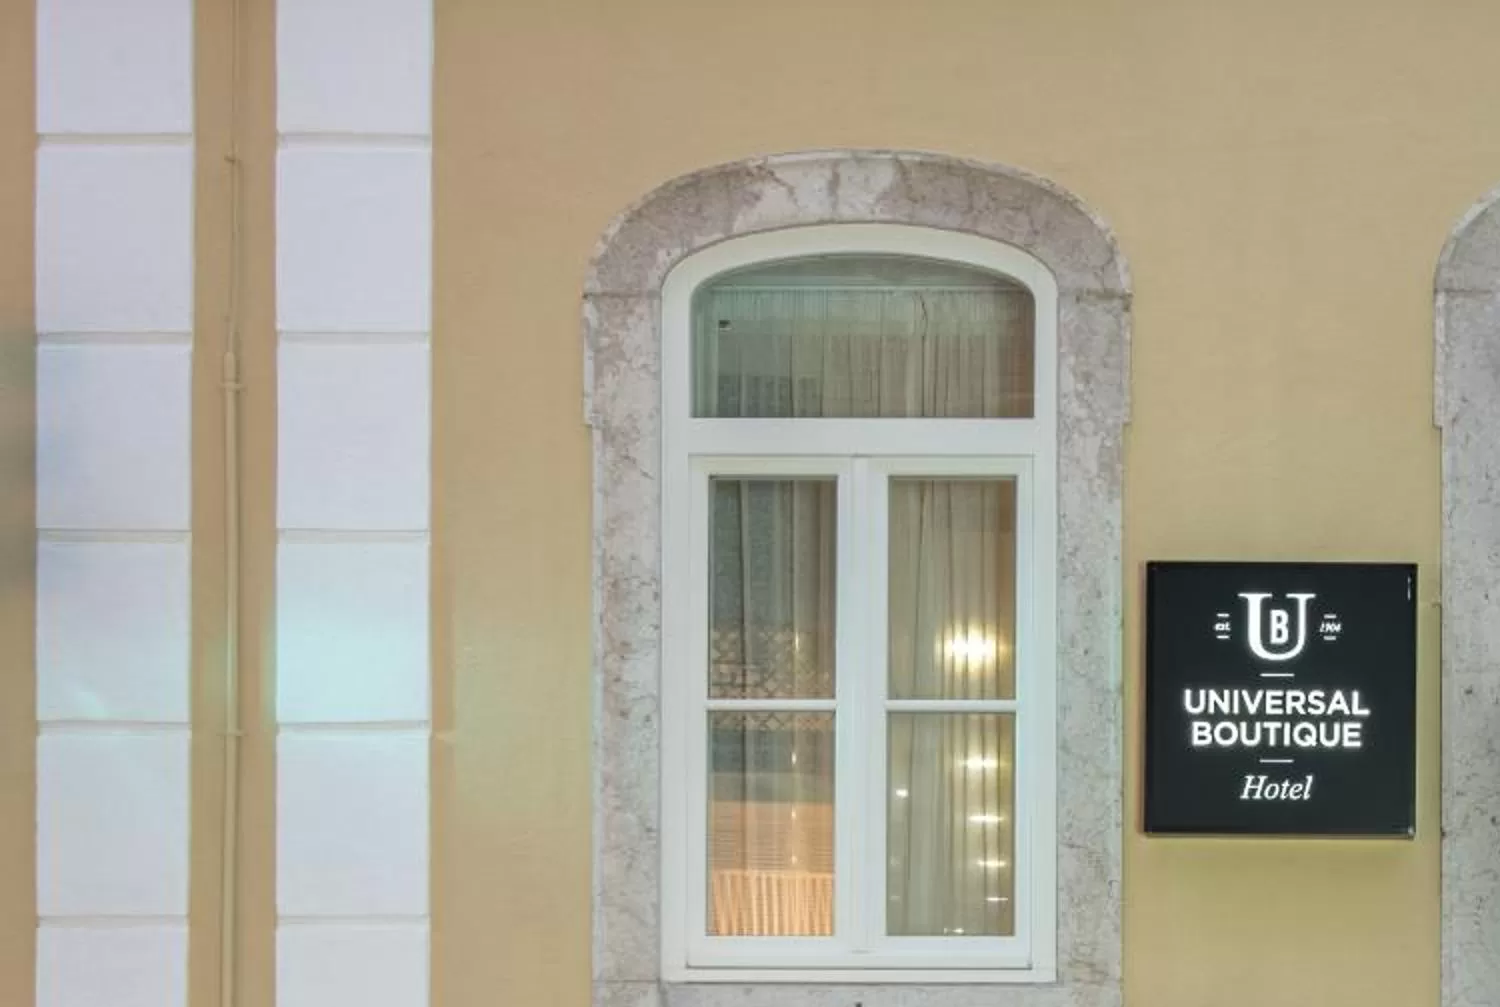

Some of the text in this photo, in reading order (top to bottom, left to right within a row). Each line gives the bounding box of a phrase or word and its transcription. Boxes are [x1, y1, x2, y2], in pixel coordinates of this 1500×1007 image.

[1184, 689, 1371, 716] UNIVERSAL
[1191, 721, 1363, 748] BOUTIQUE
[1240, 775, 1313, 801] Hotel
